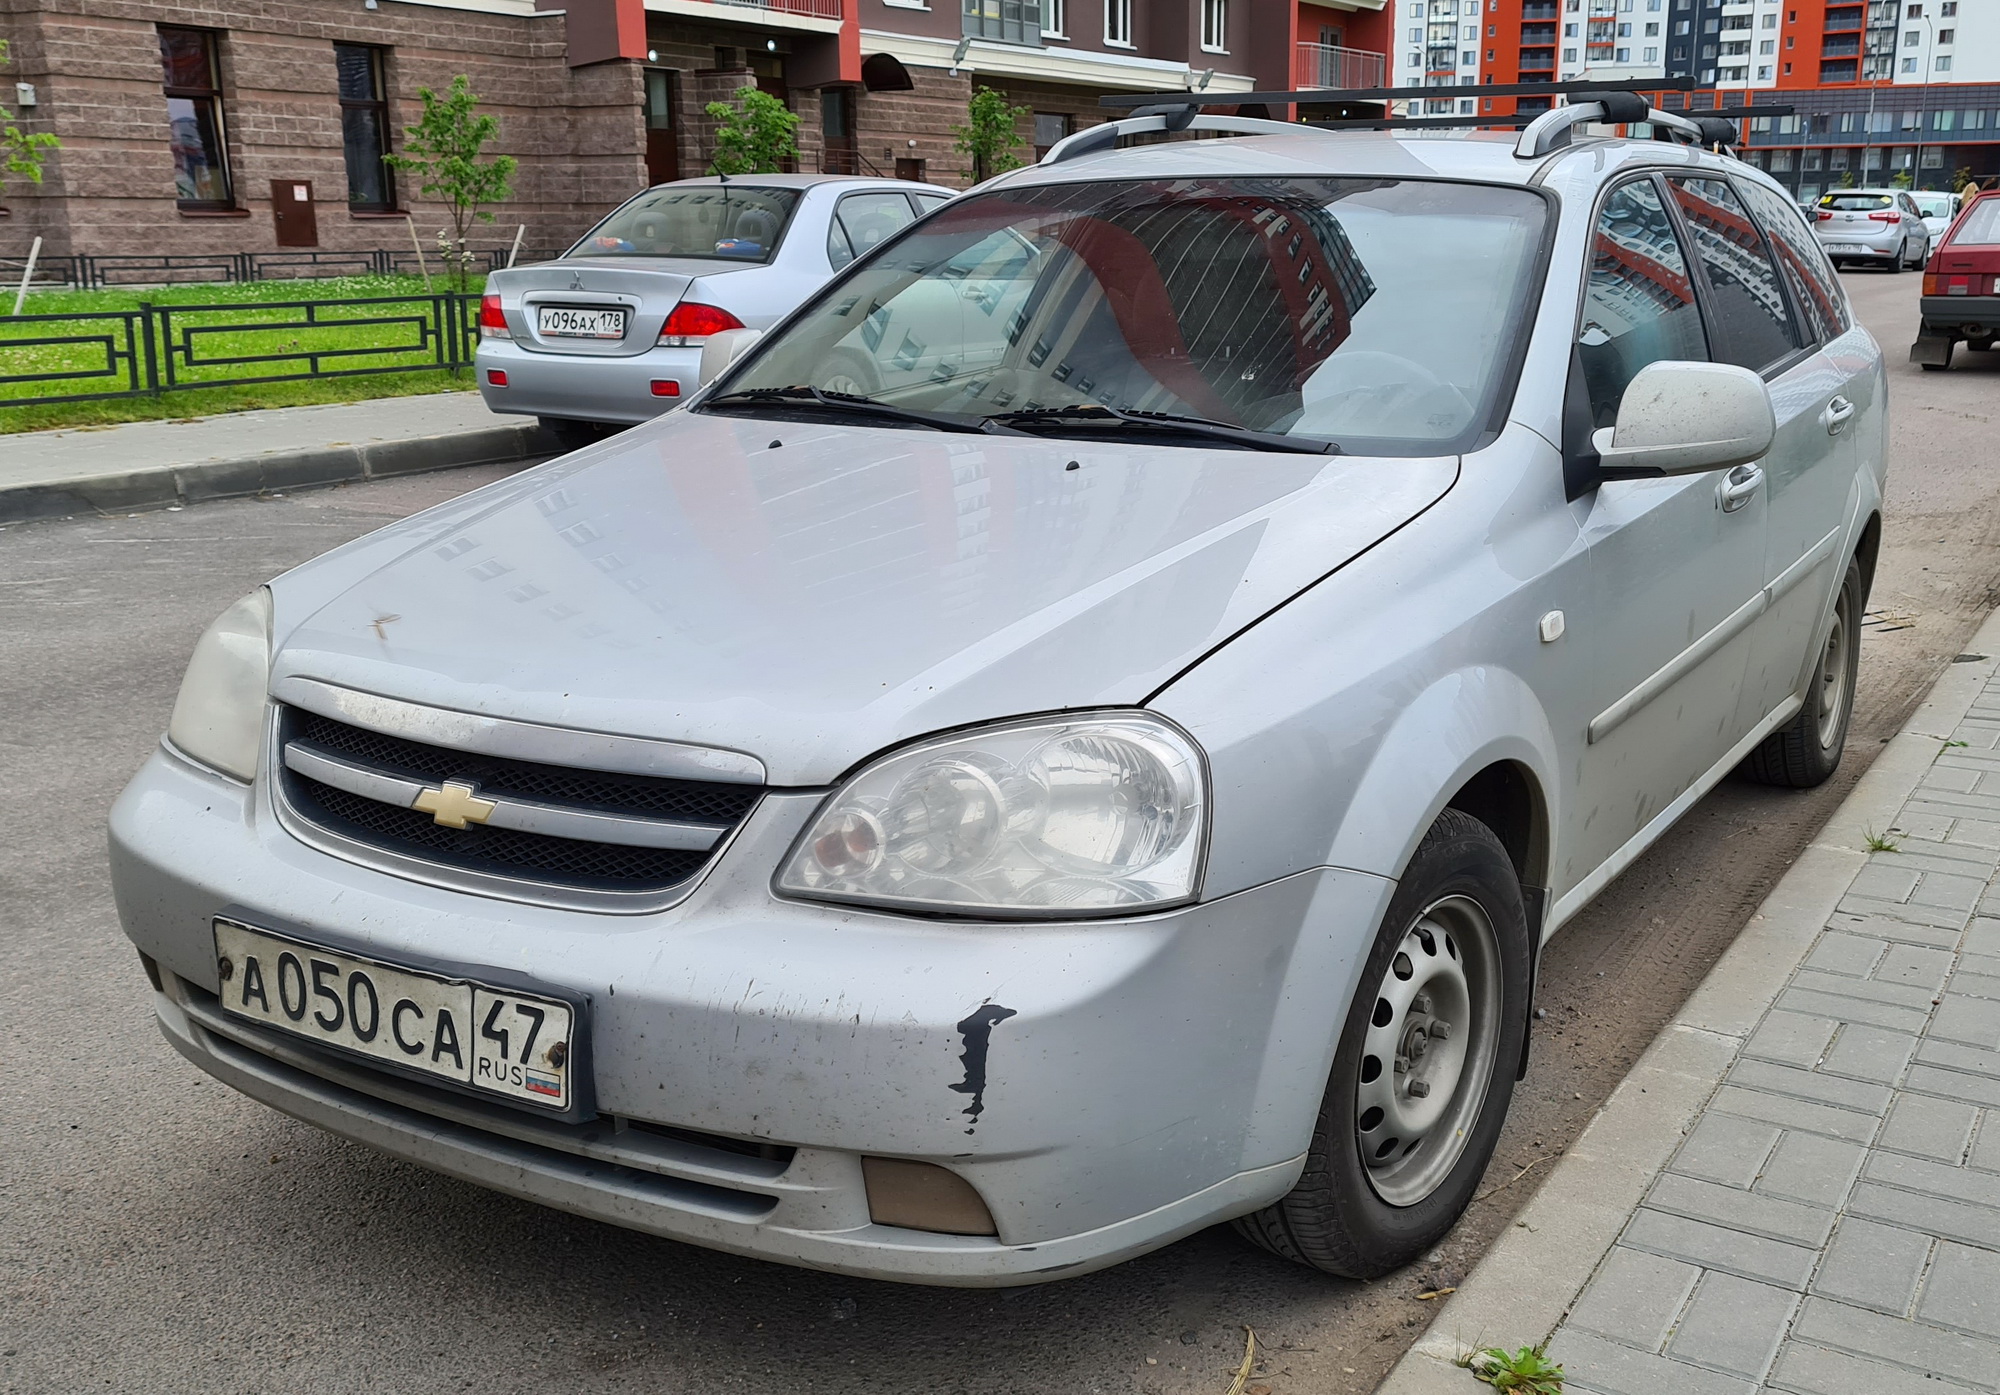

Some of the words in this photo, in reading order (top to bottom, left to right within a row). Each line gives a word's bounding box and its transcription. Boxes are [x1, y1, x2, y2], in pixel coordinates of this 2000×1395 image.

[543, 312, 597, 331] У096АХ
[600, 313, 621, 327] 178
[241, 950, 464, 1070] А050СА
[481, 999, 545, 1065] 47
[478, 1056, 523, 1087] RUS
